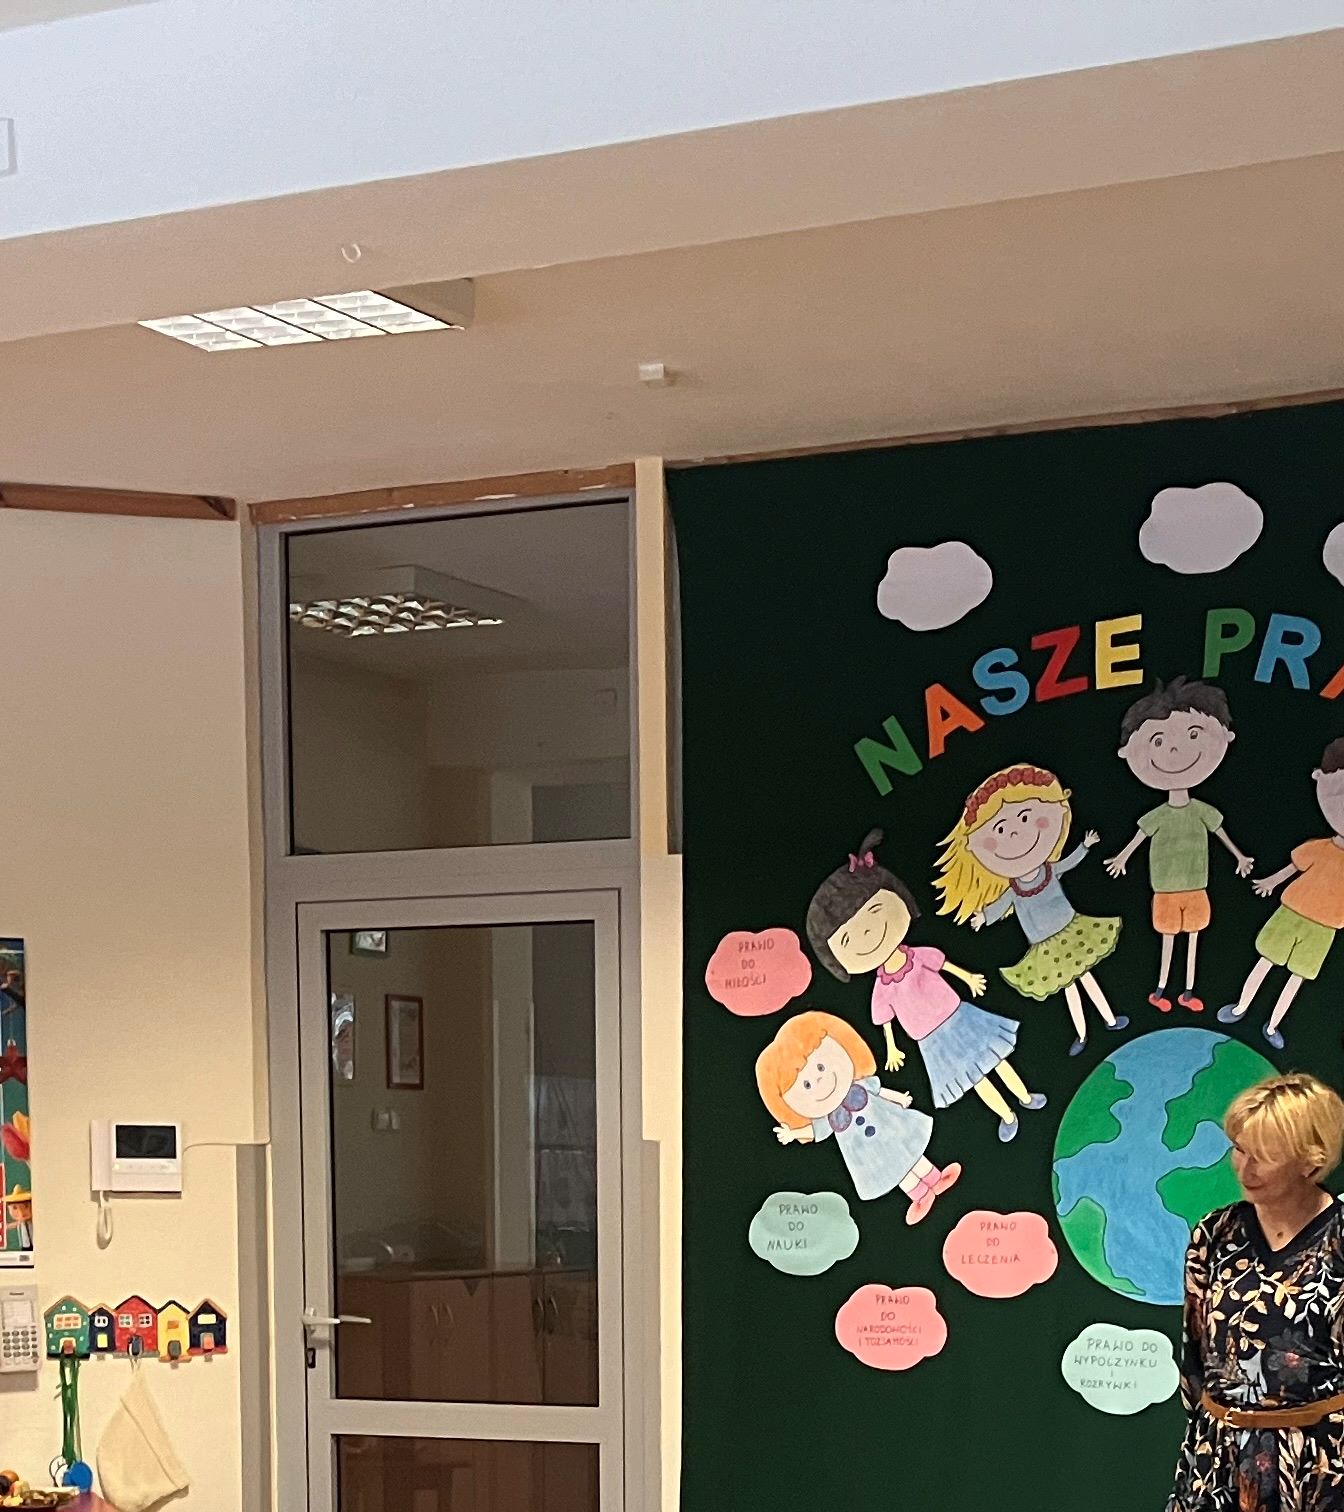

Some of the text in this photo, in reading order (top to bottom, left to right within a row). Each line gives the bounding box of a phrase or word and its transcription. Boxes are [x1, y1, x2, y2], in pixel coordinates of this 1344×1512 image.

[854, 614, 1143, 796] NASZE
[738, 938, 775, 953] PRAWO
[741, 959, 755, 969] DO
[778, 1204, 818, 1216] PRAWO
[788, 1221, 805, 1232] DO
[980, 1221, 1017, 1231] PRAWO
[767, 1238, 808, 1252] NAUKI
[986, 1237, 1000, 1247] DO
[961, 1254, 1021, 1265] LECZENIA
[875, 1294, 910, 1305] PRAWO
[880, 1311, 896, 1322] DO
[1087, 1337, 1158, 1353] PRAWO DO
[1074, 1355, 1157, 1368] WYPOCZYNKU
